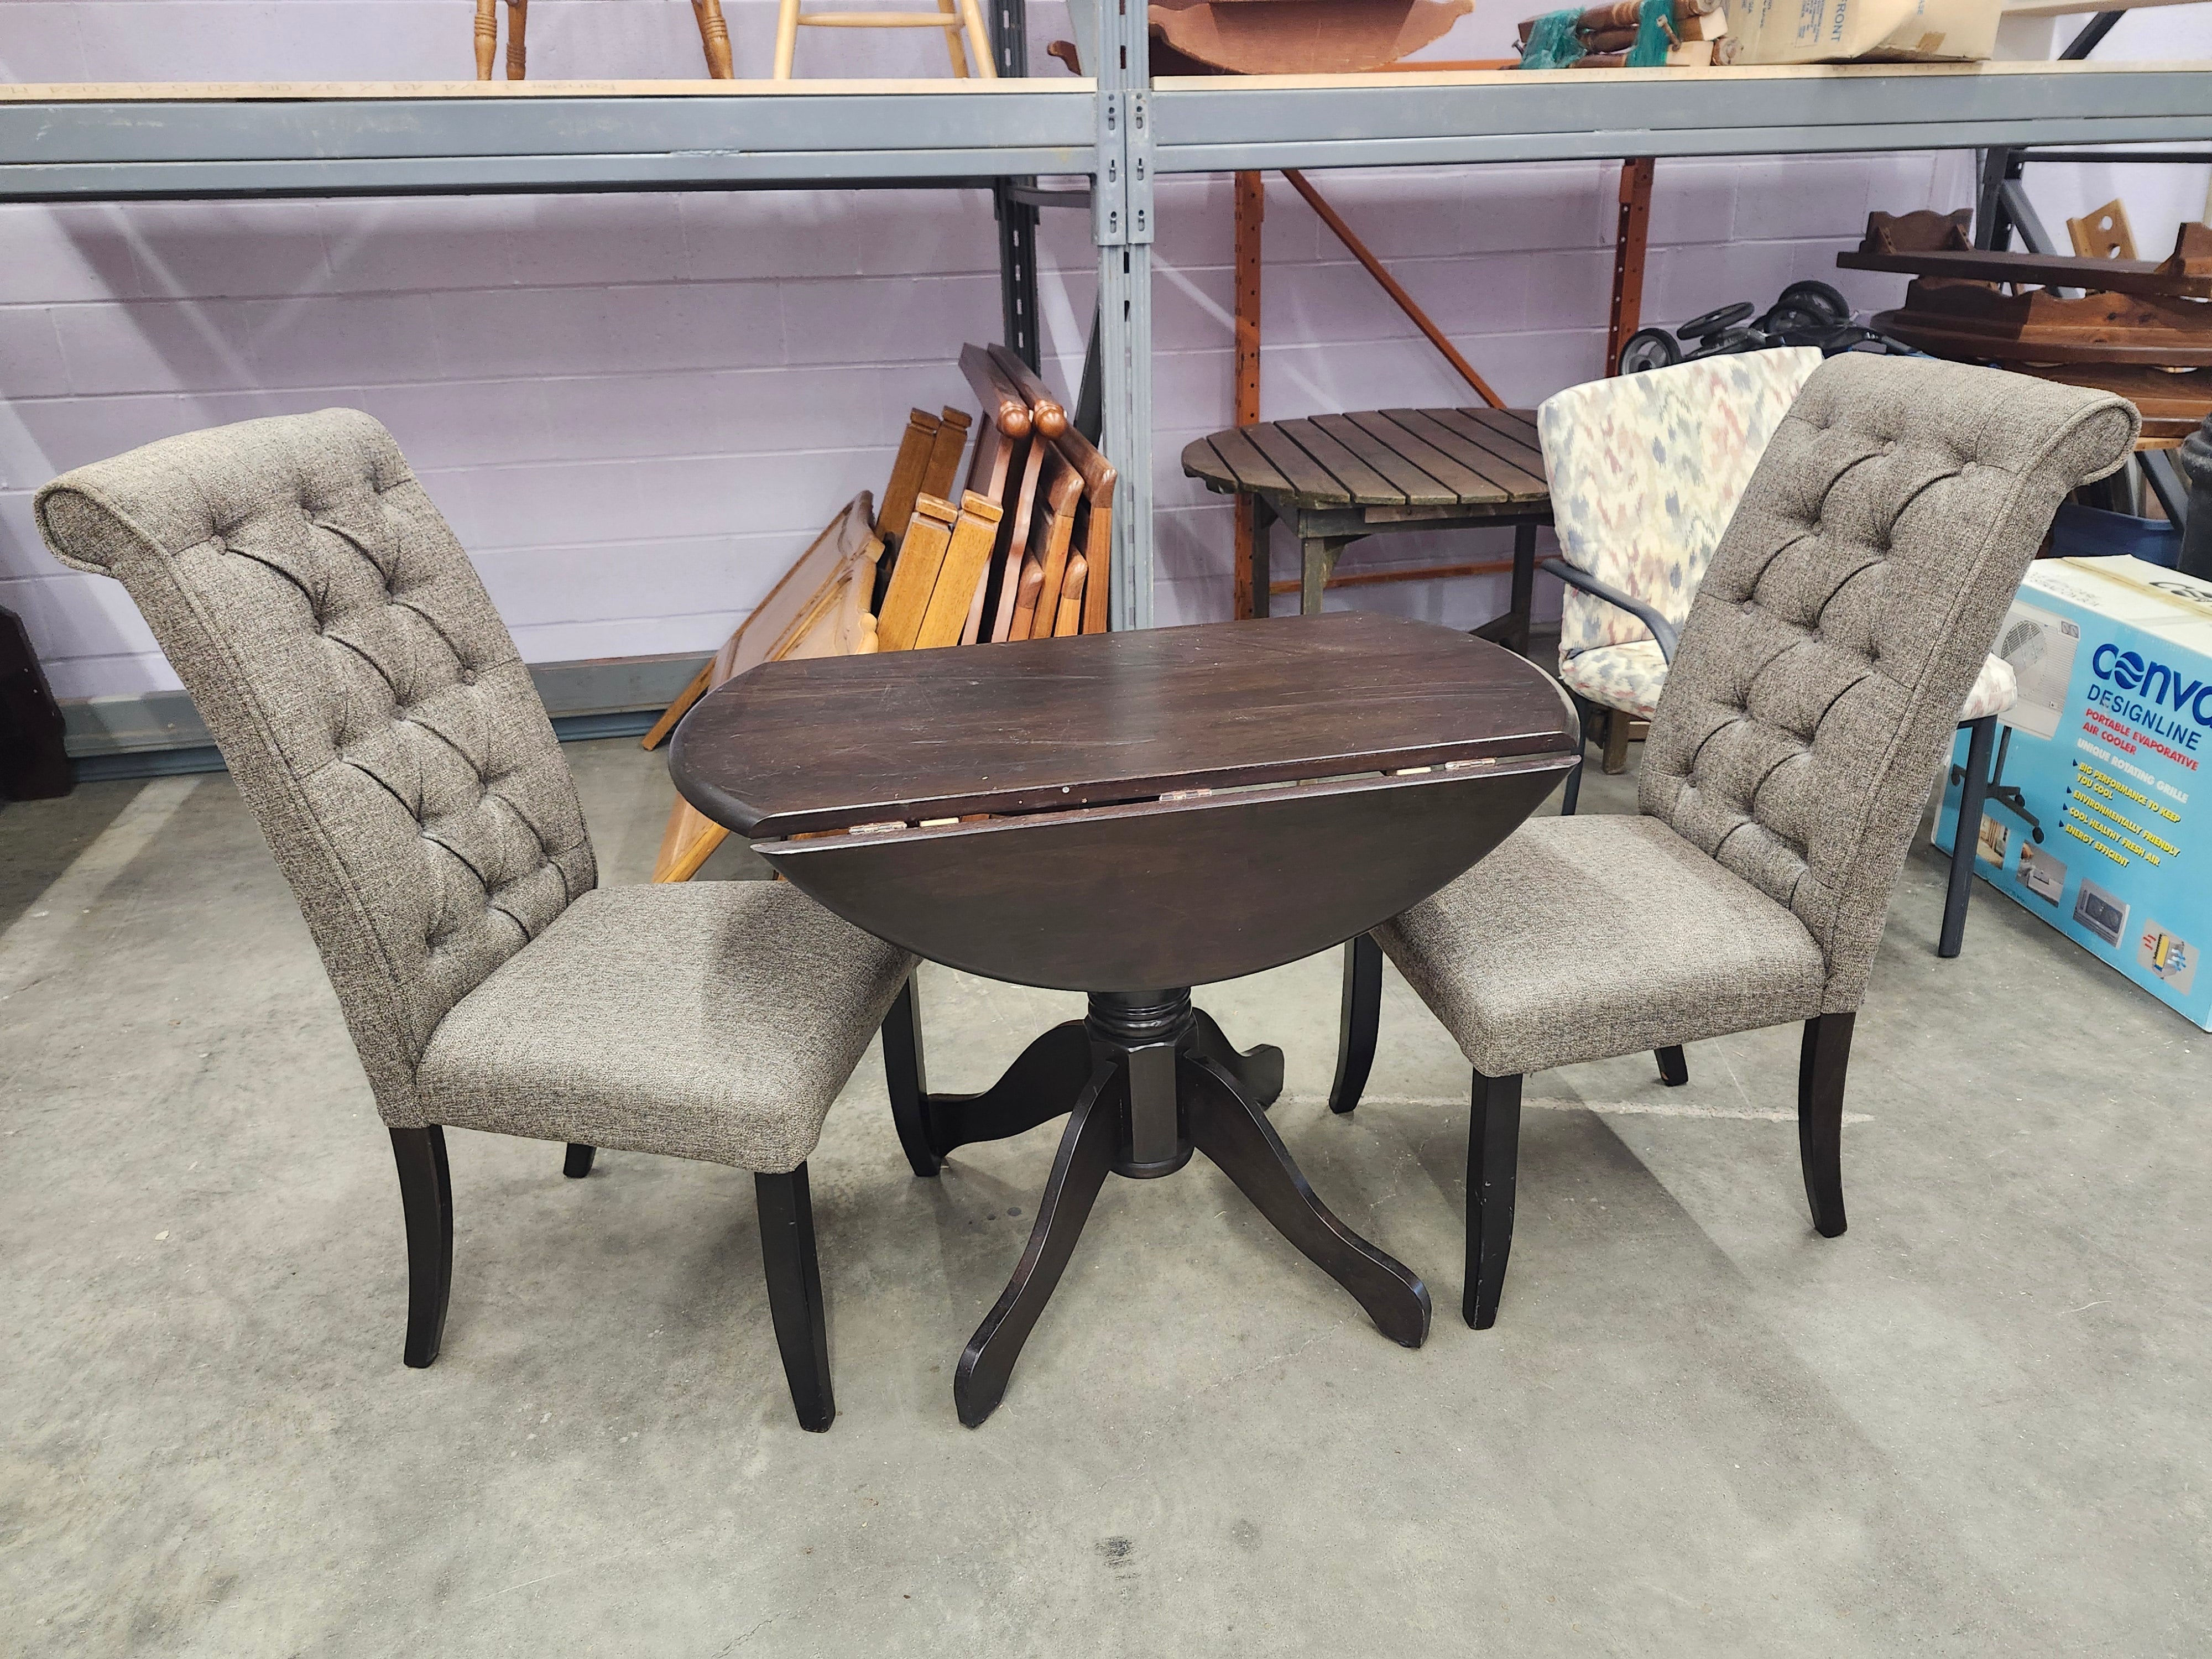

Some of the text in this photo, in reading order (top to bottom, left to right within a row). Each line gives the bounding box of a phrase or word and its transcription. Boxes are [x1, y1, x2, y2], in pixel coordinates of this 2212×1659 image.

[2082, 722, 2137, 755] AIR COOLER
[2085, 708, 2199, 771] PORTABLE EVAPORATIVE
[2087, 684, 2201, 750] DESIGNLINE
[2077, 738, 2189, 804] UNIQUE ROTATING GRILLE
[2077, 773, 2114, 800] YOU COOL
[2079, 762, 2181, 823] BIG PERFORMANCE TO KEEP
[2065, 823, 2130, 868] ENERGY EFFICIENT
[2069, 806, 2161, 867] COOL HEALTHY FRESH AIR
[2073, 790, 2180, 857] ENVIRONMENTALLY FRIENDLY
